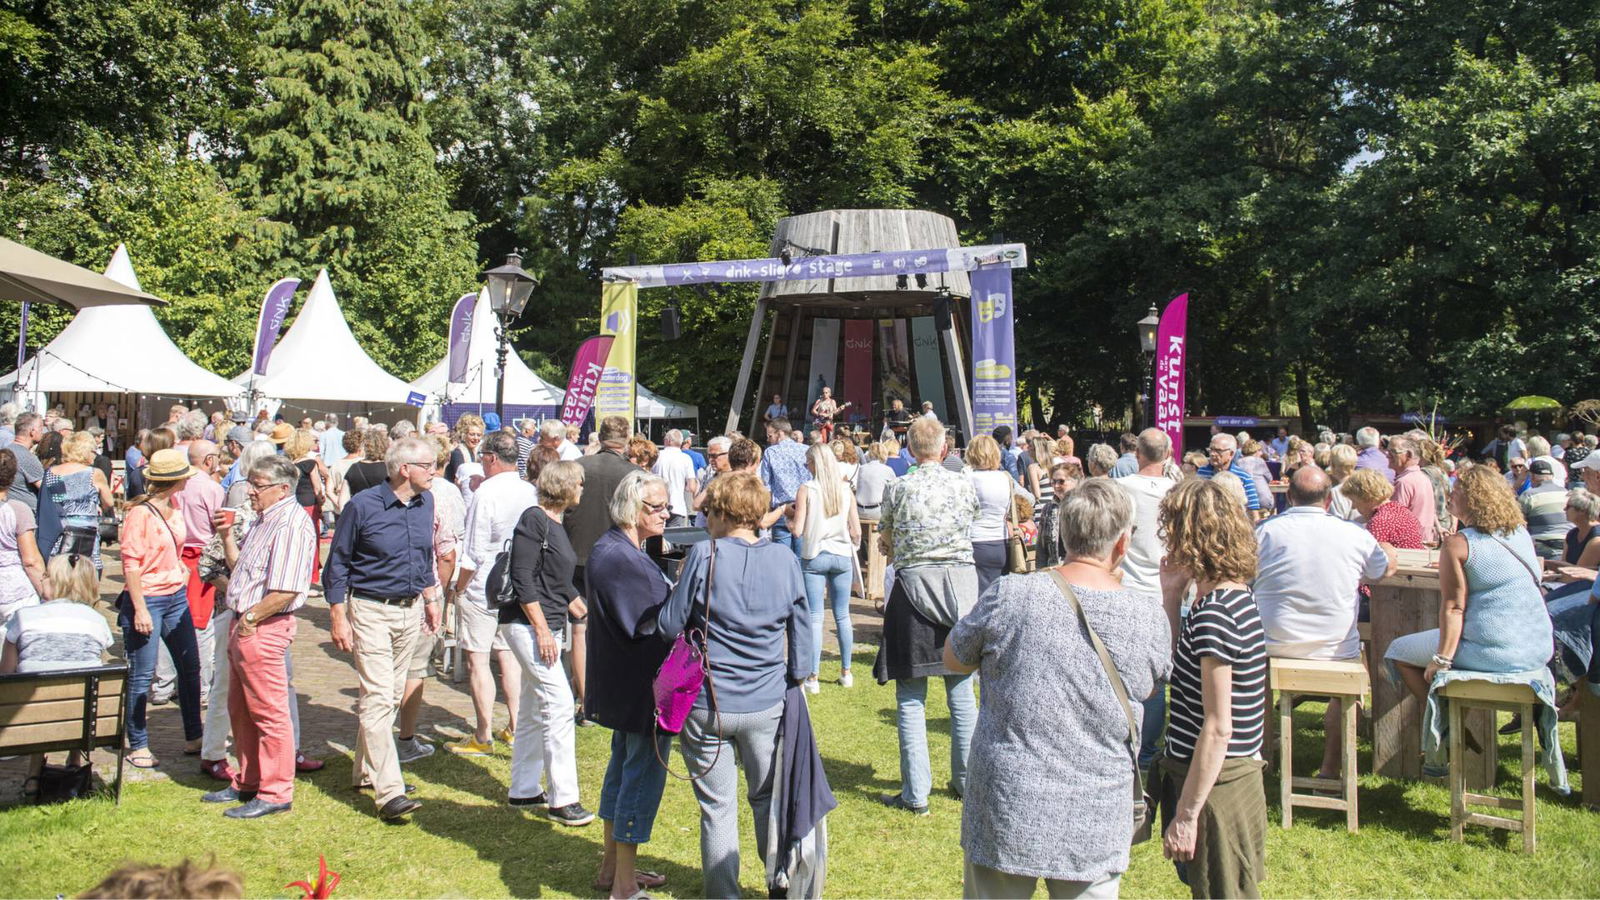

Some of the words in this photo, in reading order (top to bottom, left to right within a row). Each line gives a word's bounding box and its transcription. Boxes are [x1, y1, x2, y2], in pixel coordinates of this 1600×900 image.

[809, 259, 853, 276] stage
[1158, 374, 1168, 434] vaar
[1168, 335, 1184, 433] kunst
